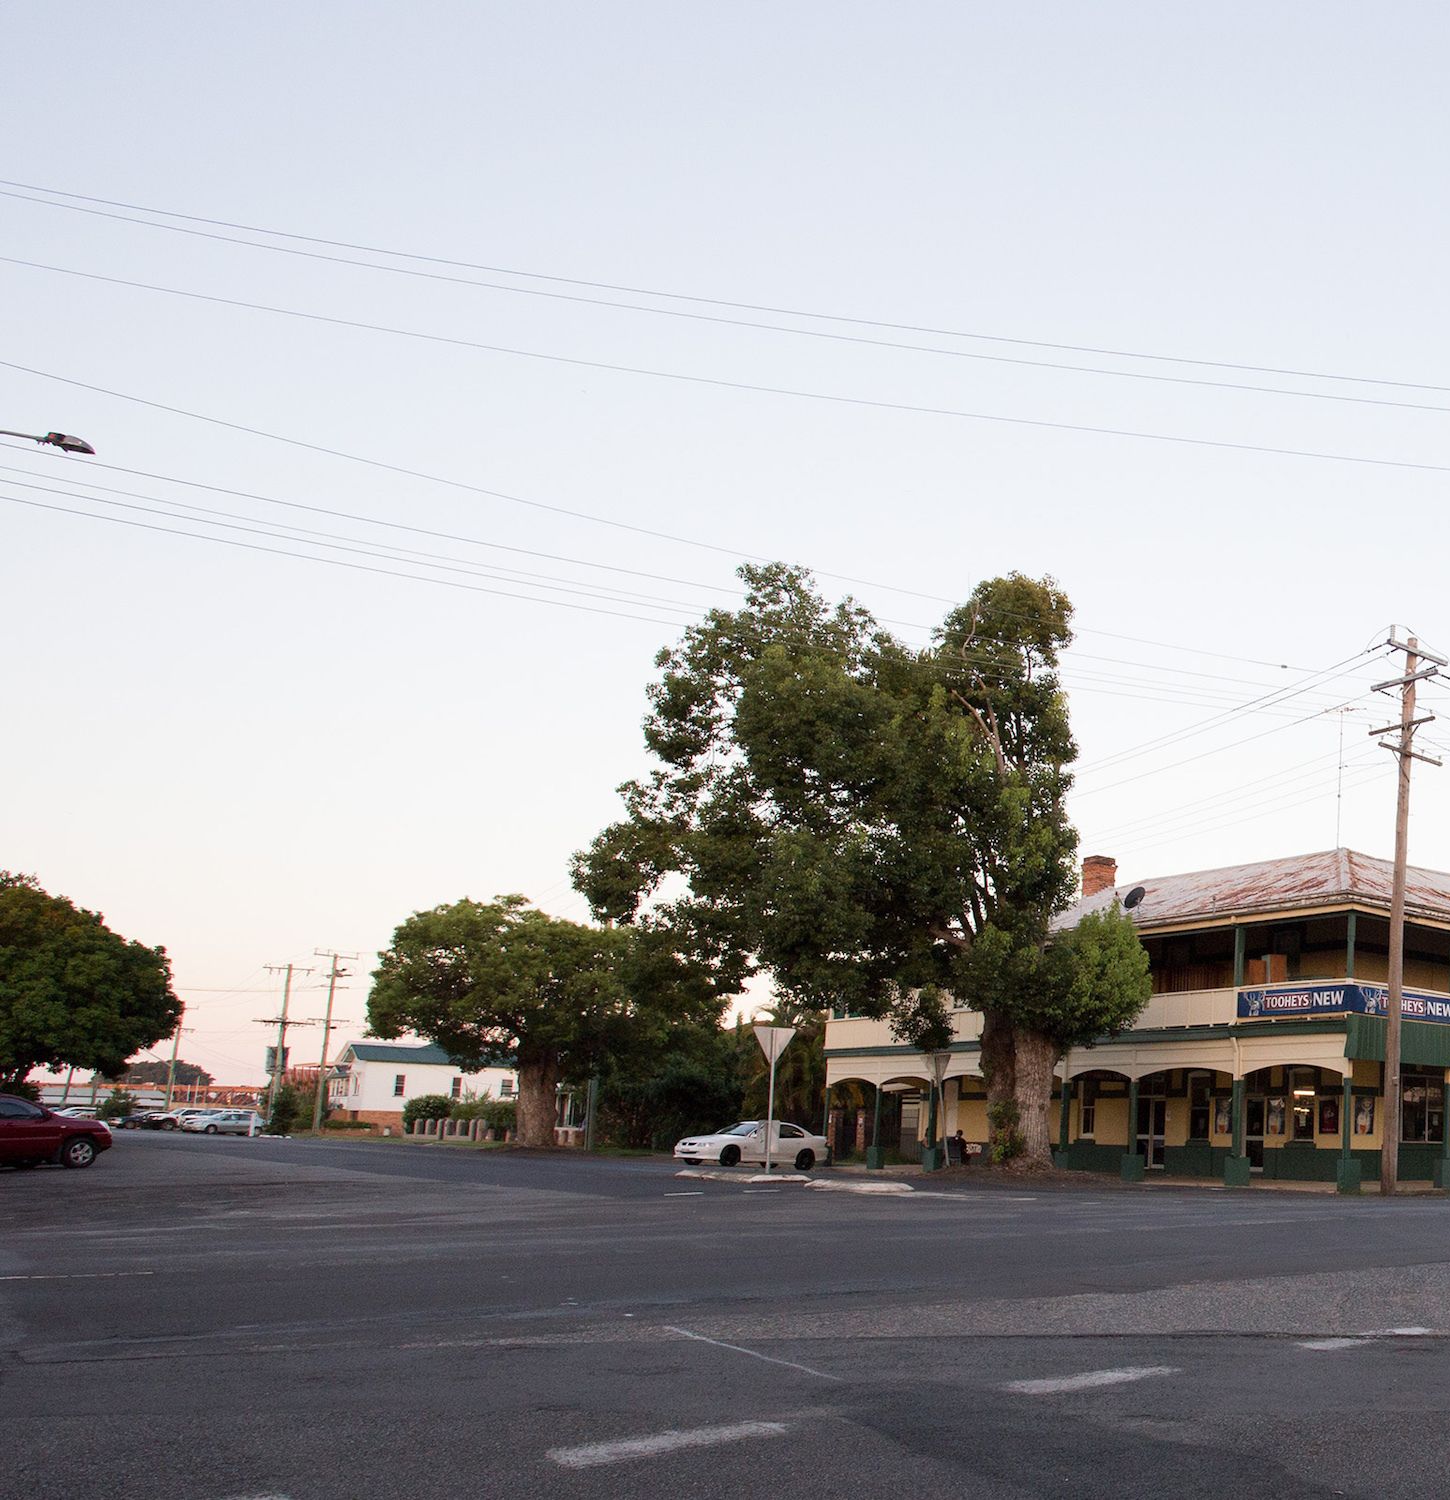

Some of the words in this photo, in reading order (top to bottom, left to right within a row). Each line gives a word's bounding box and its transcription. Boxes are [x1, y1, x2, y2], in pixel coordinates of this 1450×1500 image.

[1265, 993, 1310, 1008] TOOHEYS
[1312, 990, 1345, 1007] NEW
[1381, 996, 1425, 1014] THEYS
